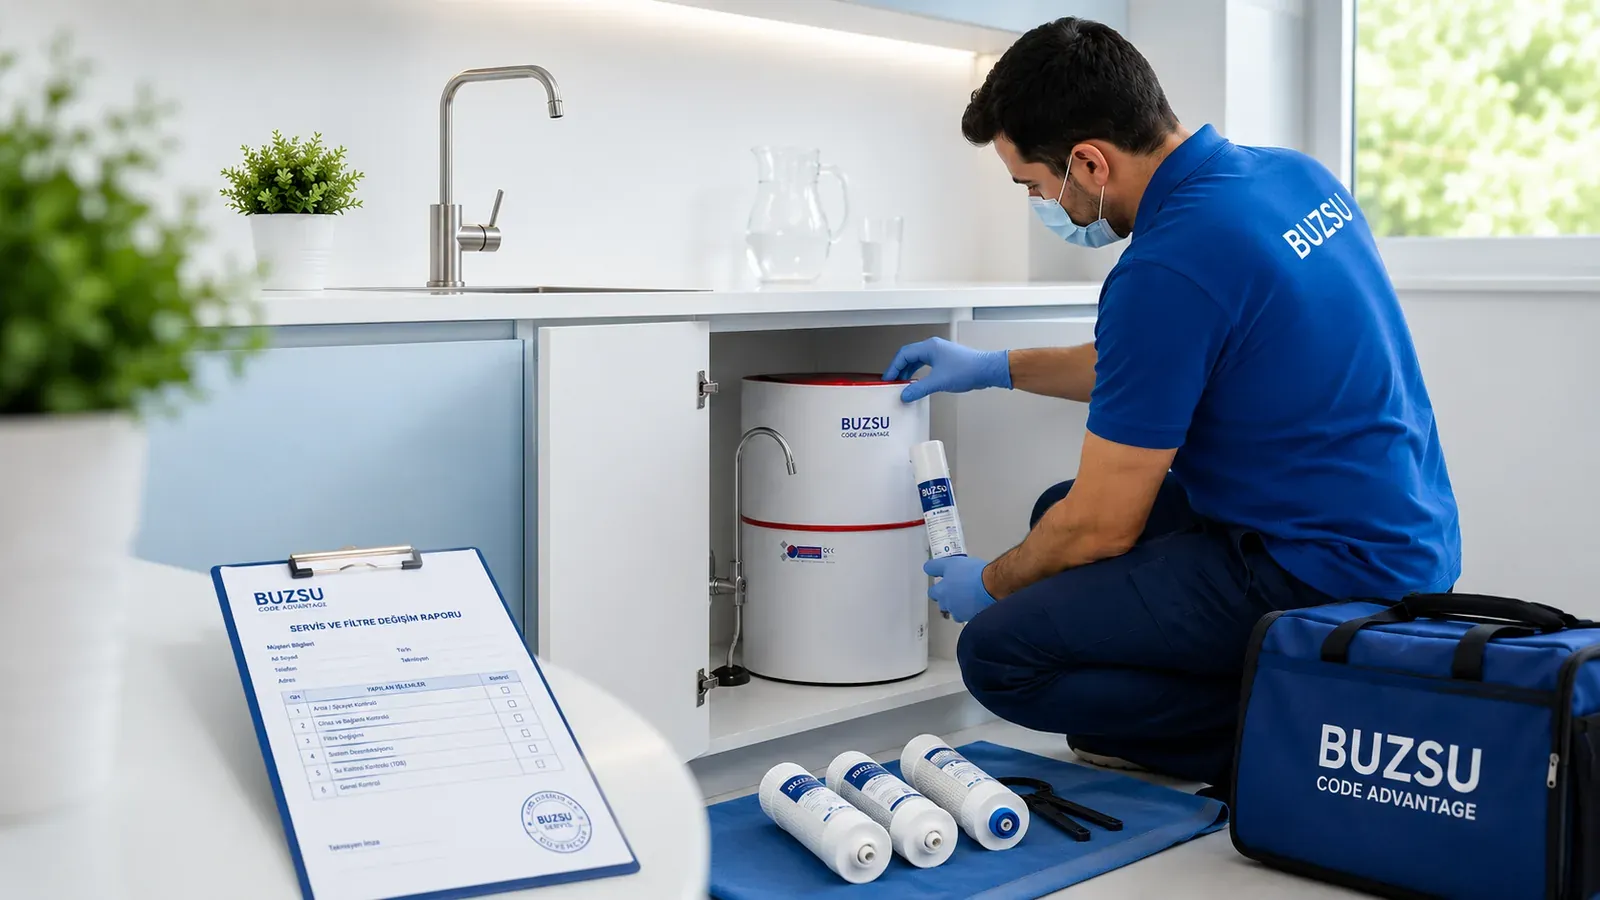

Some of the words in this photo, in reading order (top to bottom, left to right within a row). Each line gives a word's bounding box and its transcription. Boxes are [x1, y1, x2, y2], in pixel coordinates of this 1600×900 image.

[1282, 192, 1353, 260] BUZSU
[841, 416, 890, 430] BUZSU
[253, 587, 324, 606] BUZSU
[327, 621, 342, 629] VE
[420, 610, 462, 621] RAPORU
[1318, 723, 1482, 794] BUZSU
[1316, 775, 1362, 799] CODE
[1367, 785, 1477, 821] ADVANTAGE
[537, 812, 572, 824] BUZSU
